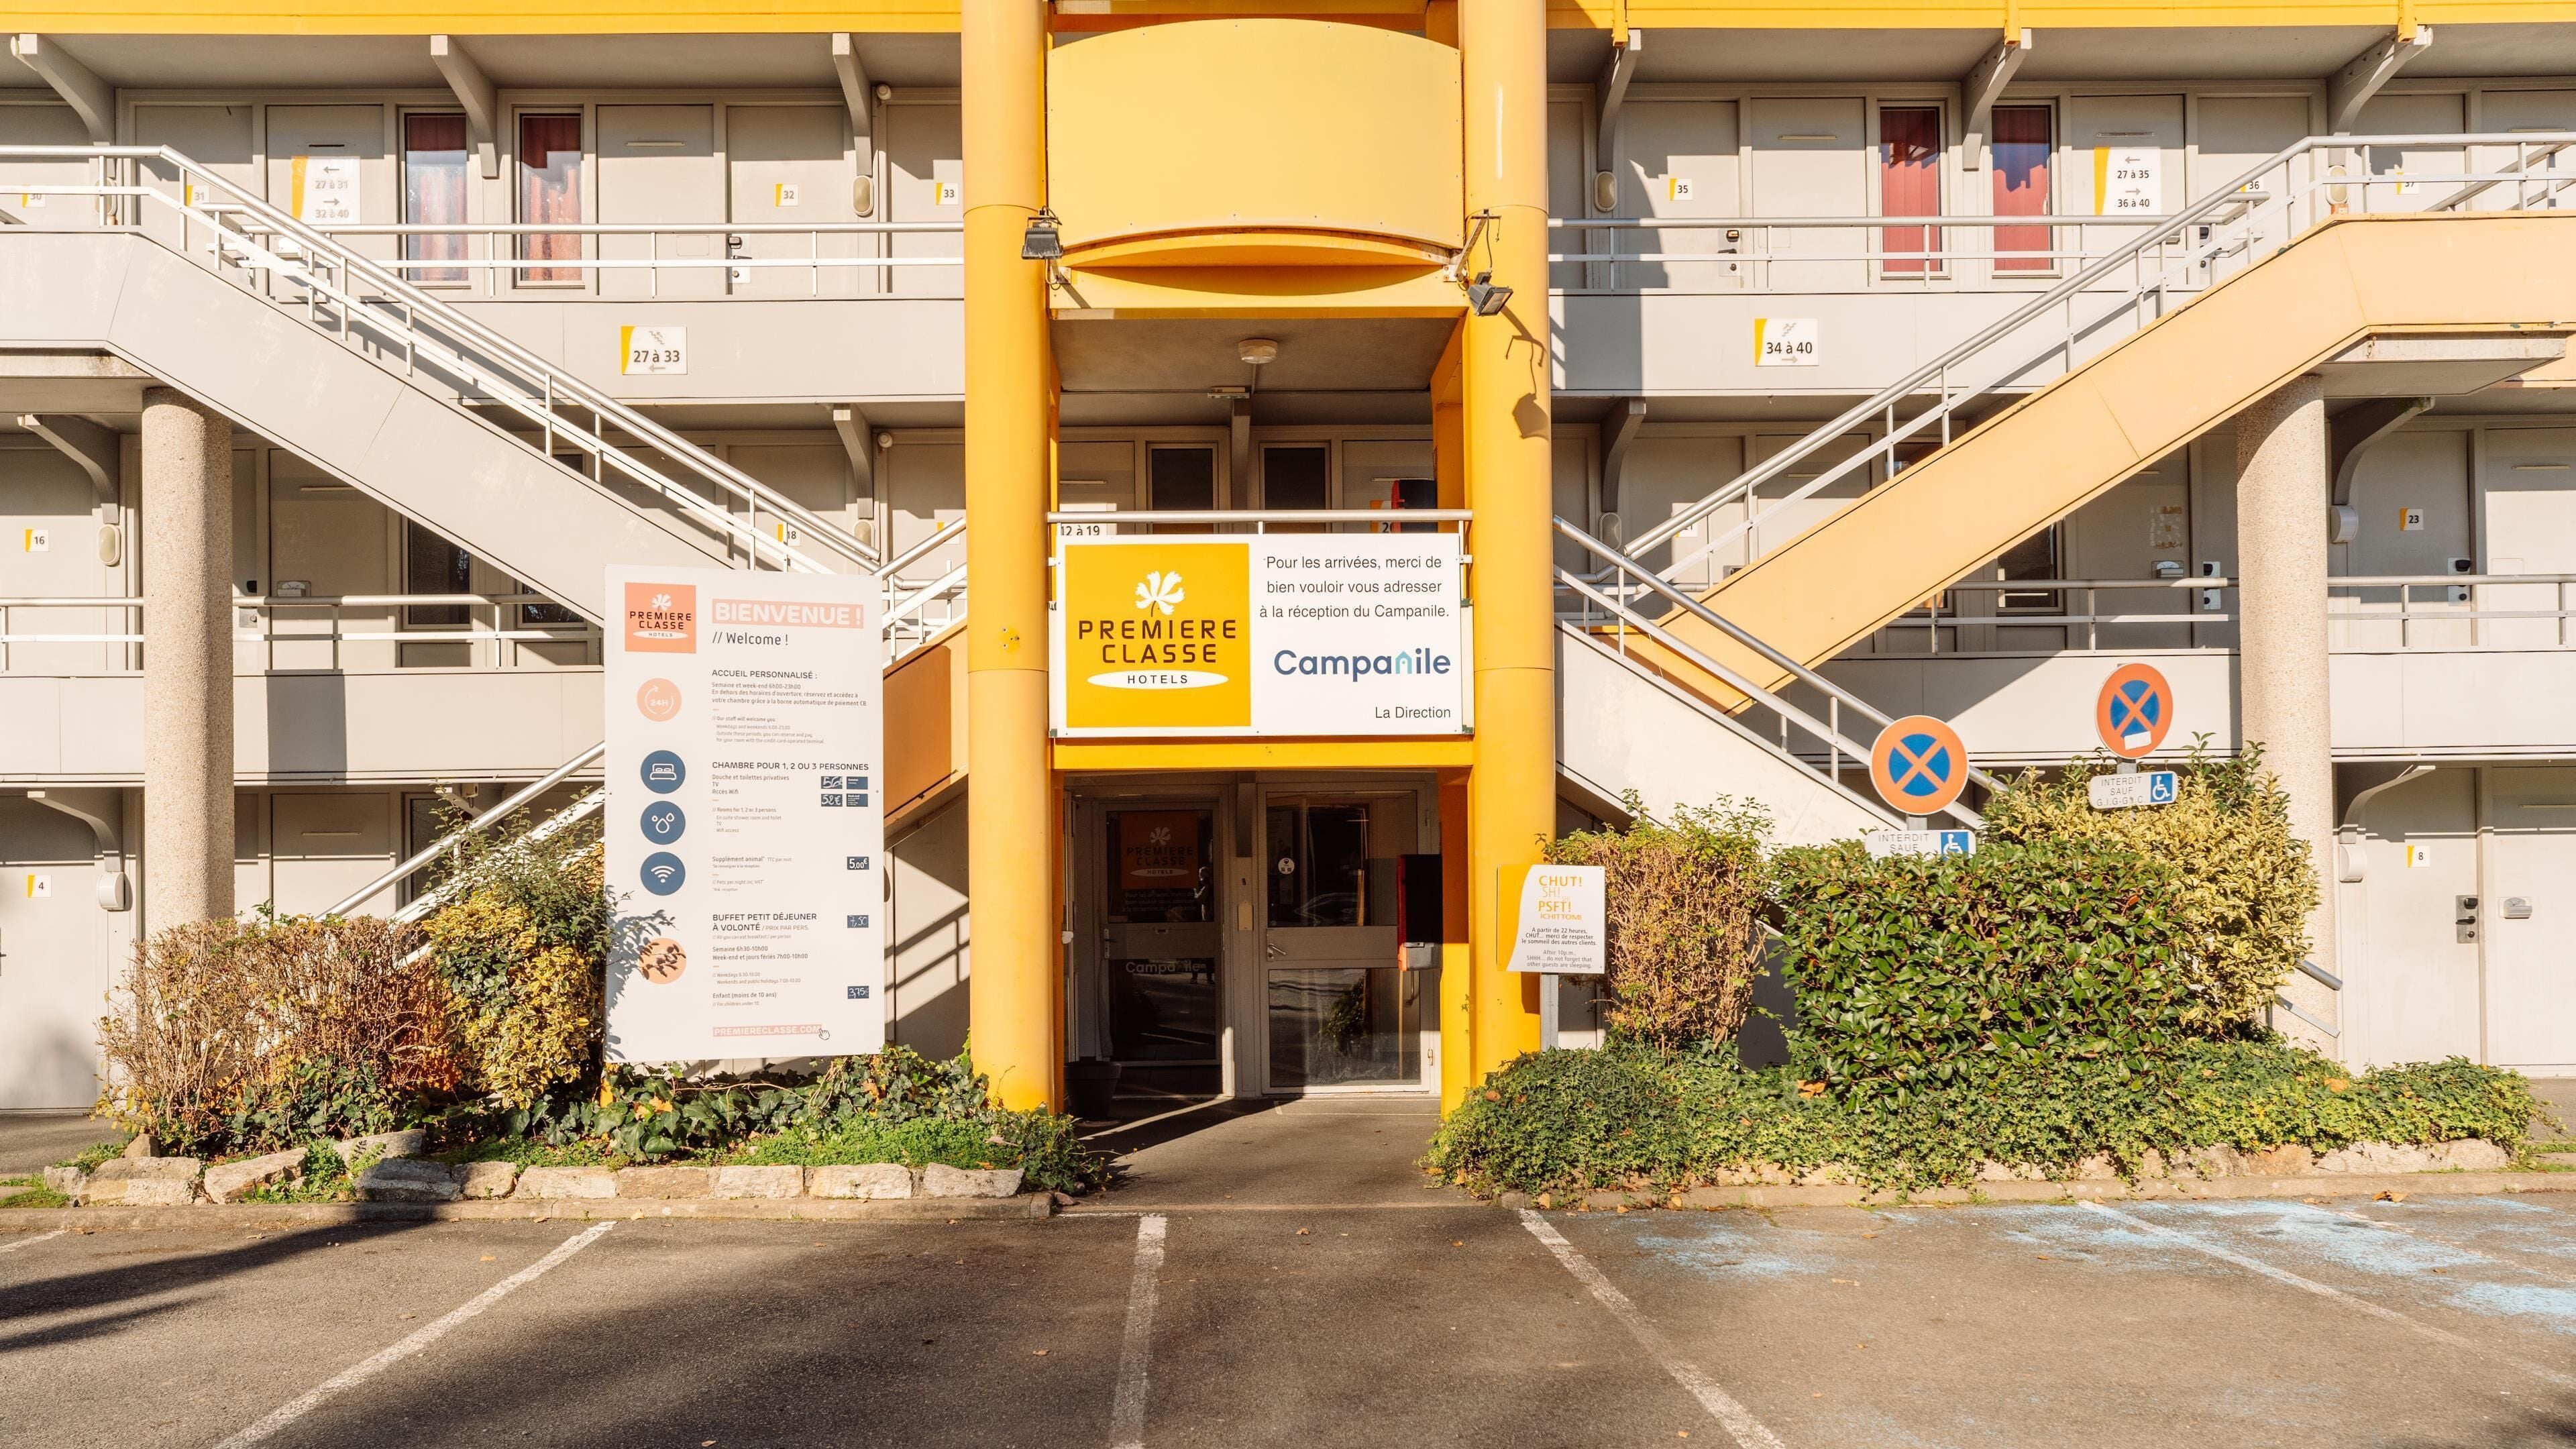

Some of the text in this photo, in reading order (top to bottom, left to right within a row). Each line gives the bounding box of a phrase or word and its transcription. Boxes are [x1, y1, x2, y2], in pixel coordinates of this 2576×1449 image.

[2117, 169, 2149, 179] 27 à 35
[315, 179, 348, 189] 27 à 31
[1678, 184, 1688, 193] 35
[2249, 180, 2259, 189] 36
[194, 193, 204, 201] 31
[784, 191, 794, 199] 32
[944, 189, 955, 198] 33
[2117, 197, 2149, 207] 36 à 40
[315, 208, 349, 218] 32 à 40
[1766, 340, 1813, 354] 34 à 40
[633, 349, 680, 362] 27 à 33
[2408, 515, 2419, 523] 23
[787, 531, 796, 539] 18
[1061, 525, 1100, 536] 12 à 19
[34, 536, 45, 545] 16
[1267, 556, 1442, 572] Pour les arrivées, merci de
[1267, 580, 1442, 594] bien vouloir vous adresser
[630, 611, 692, 621] PREMIERE
[715, 602, 850, 625] BIENVENUE
[1260, 604, 1450, 621] à la réception du Campanile.
[639, 621, 684, 630] CLASSE
[1079, 619, 1237, 639] PREMIERE
[727, 632, 782, 646] Welcome
[1102, 644, 1218, 663] CLASSE
[1274, 647, 1451, 682] Campanile
[750, 671, 813, 679] PERSONNALISÉ
[1127, 675, 1189, 685] HOTELS
[1375, 706, 1451, 718] La Direction
[2101, 777, 2142, 786] INTERDIT
[2110, 787, 2133, 796] SAUF
[1878, 834, 1929, 842] INTERDIT
[1127, 847, 1193, 856] PREMIERE
[1890, 844, 1919, 852] SAUF
[1137, 857, 1186, 865] CLASSE
[2418, 852, 2424, 860] 8
[38, 881, 44, 890] 4
[1539, 875, 1582, 887] CHUT!
[1542, 887, 1560, 898] SH!
[1538, 901, 1571, 912] PSFT!
[773, 912, 817, 920] DÉJEUNER
[712, 922, 718, 931] À
[720, 922, 761, 931] VOLONTÉ
[714, 1026, 820, 1036] PREMIERECLASSE.COM
